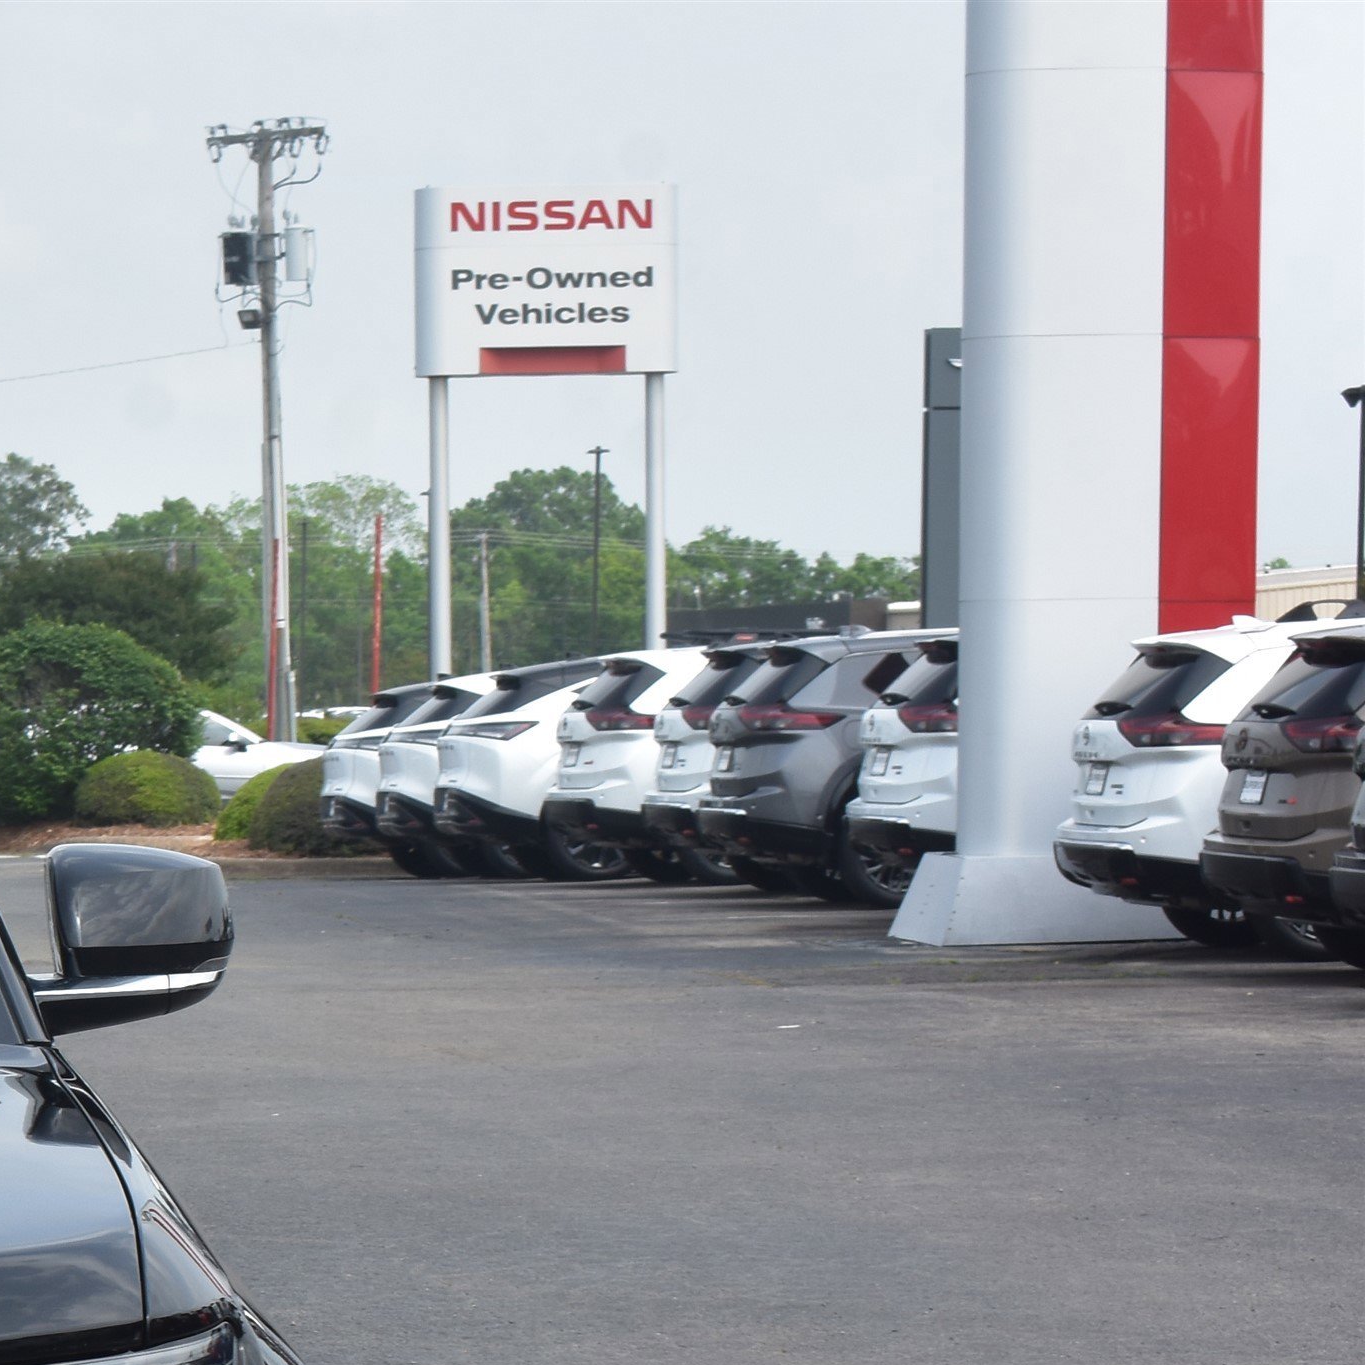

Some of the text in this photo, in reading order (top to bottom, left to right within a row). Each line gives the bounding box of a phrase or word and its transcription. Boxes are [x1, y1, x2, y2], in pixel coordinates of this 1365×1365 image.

[450, 198, 653, 232] NISSAN
[450, 265, 655, 291] Pre-Owned
[474, 302, 631, 326] Vehicles
